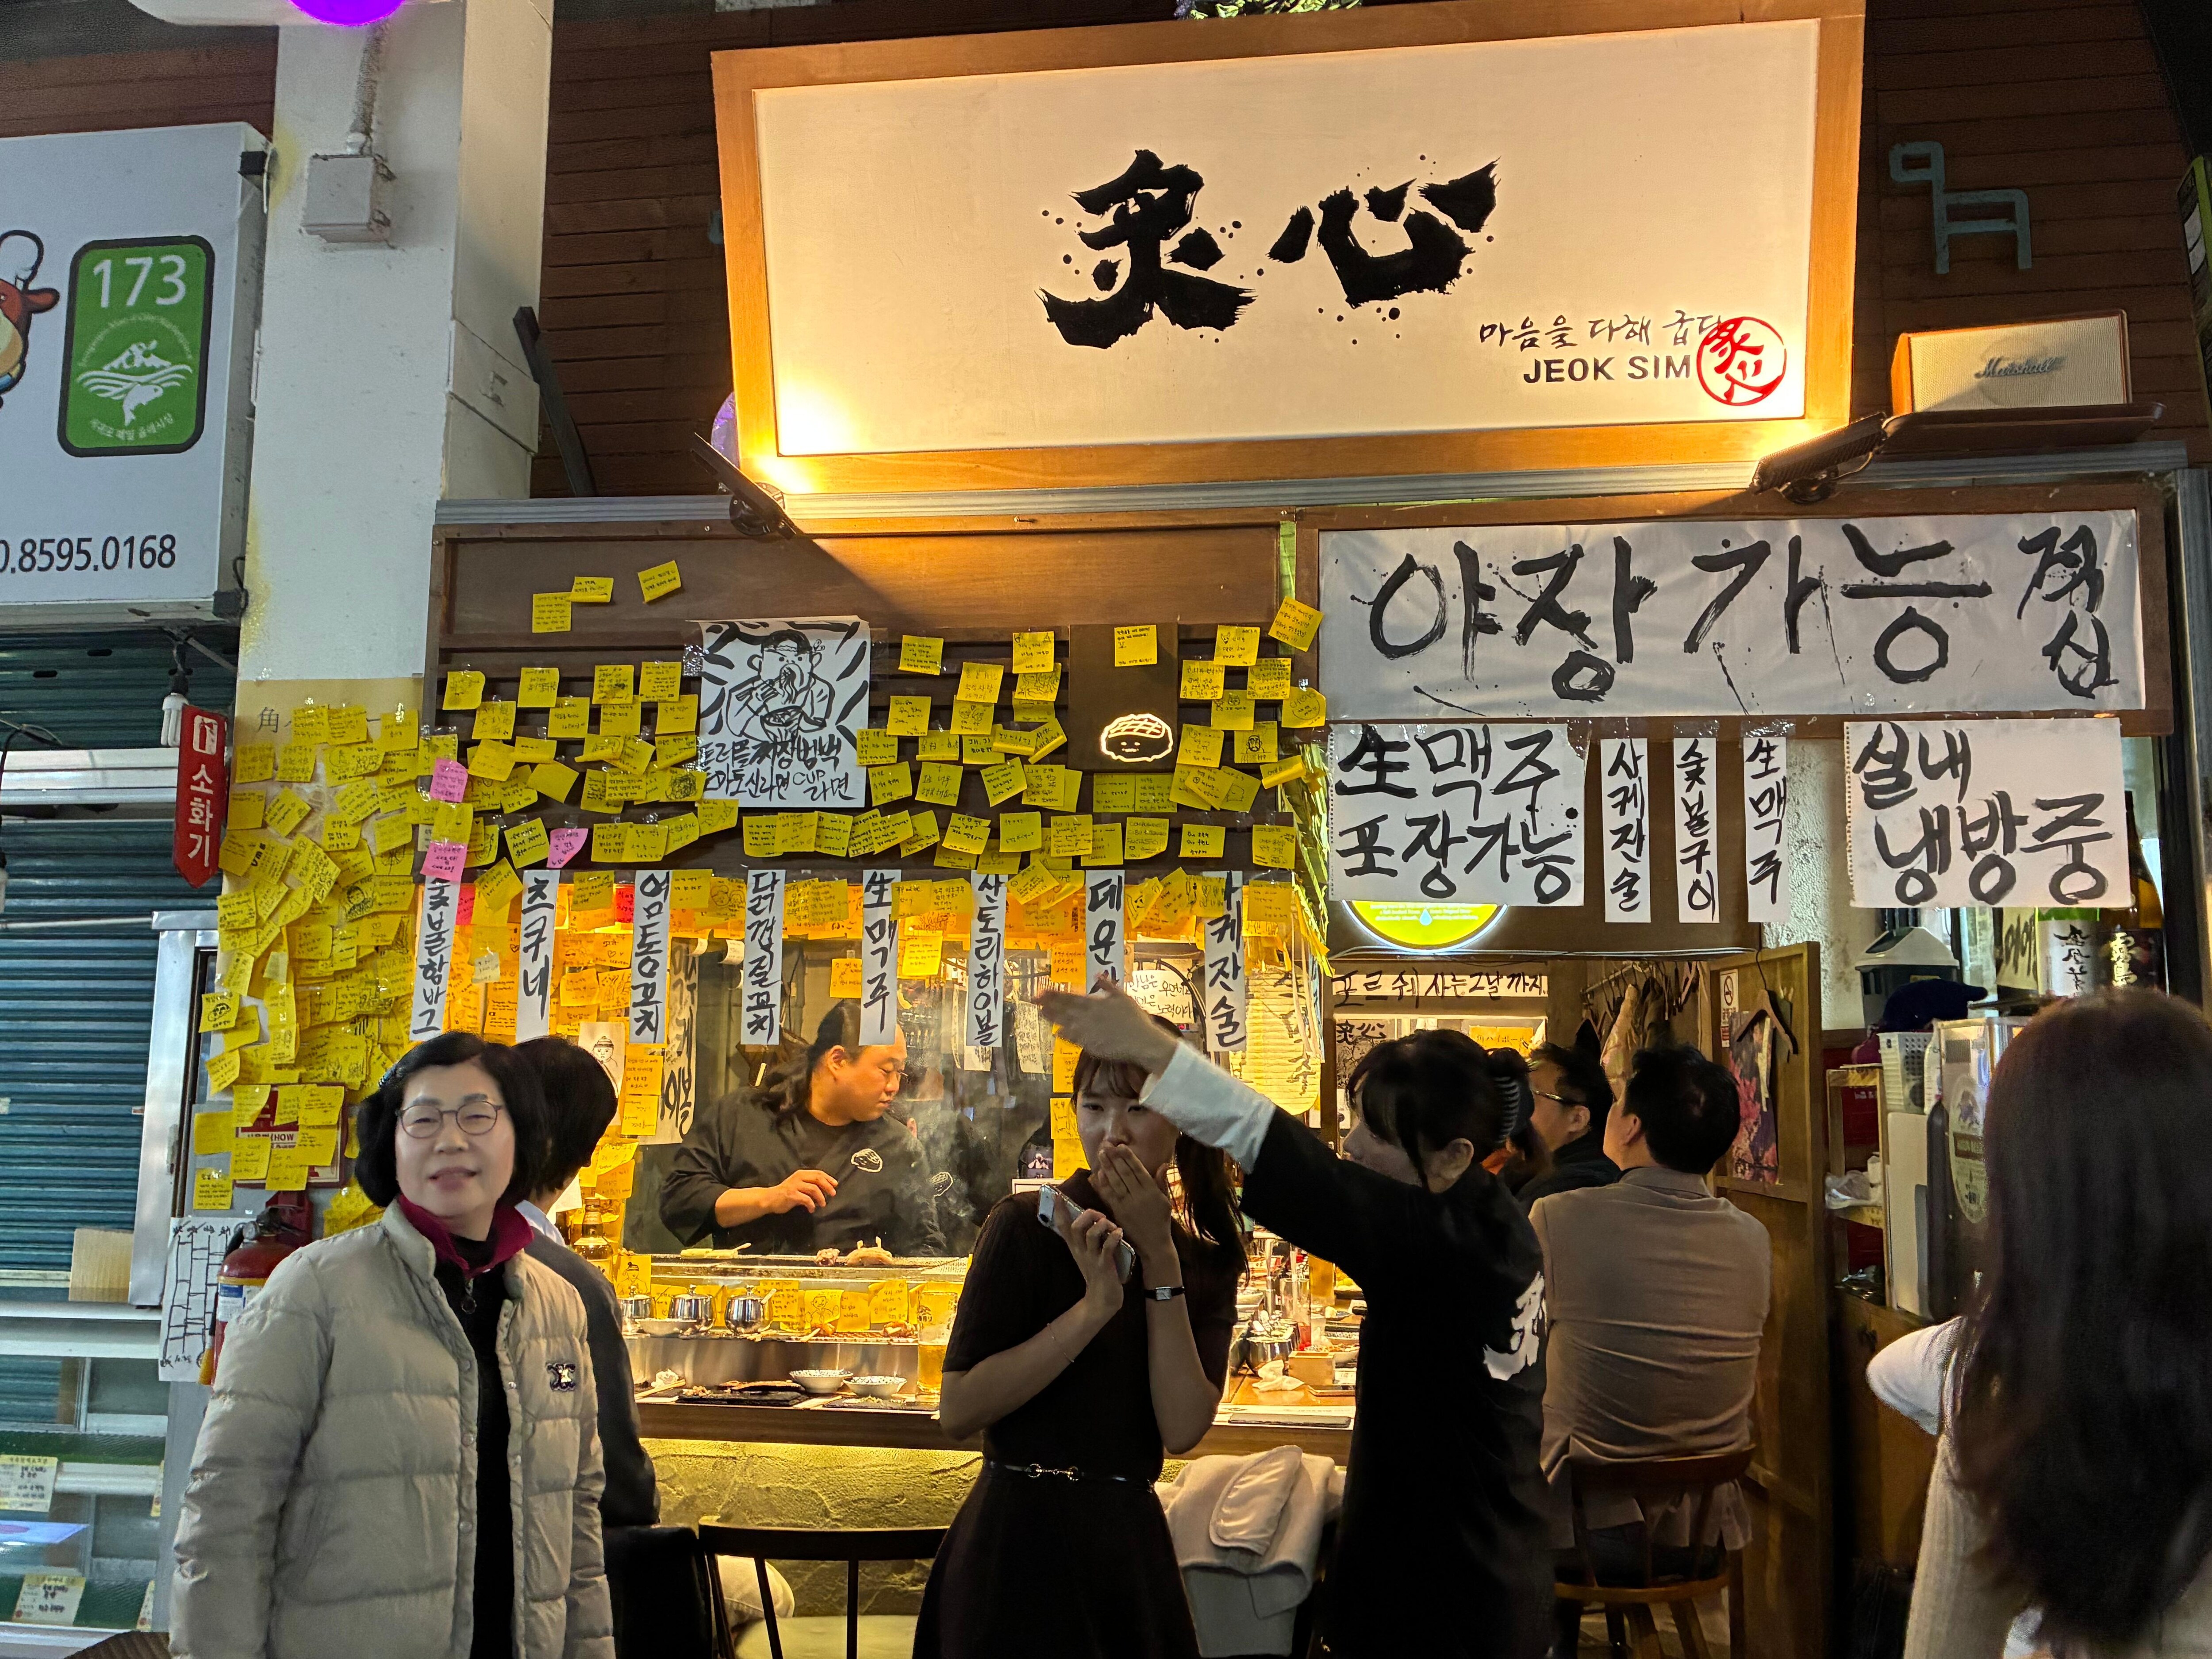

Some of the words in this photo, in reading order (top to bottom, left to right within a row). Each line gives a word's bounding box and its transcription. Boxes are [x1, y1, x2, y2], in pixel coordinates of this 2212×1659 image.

[93, 254, 187, 307] 173
[1479, 315, 1578, 352] 마음을
[1589, 314, 1651, 346] 다해
[1523, 357, 1615, 383] JEOK
[1627, 354, 1690, 379] SIM
[1974, 356, 2057, 379] Marshall
[1369, 523, 1992, 702] 야장가능
[188, 764, 213, 867] 소화기
[793, 769, 826, 786] CUP
[803, 772, 857, 802] 라면
[1335, 724, 1560, 834] 生맥주
[1852, 720, 1972, 810] 실내
[1335, 810, 1573, 904] 포장가능
[1607, 741, 1646, 912] 사케잔술
[1675, 740, 1716, 921] 숯불구이
[1744, 737, 1787, 905] 生맥주
[1875, 790, 2116, 906] 냉방중
[521, 877, 555, 1021] 츠쿠네
[631, 871, 670, 1044] 염통꼬치
[746, 872, 782, 1044] 닭껍질꼬치
[973, 873, 1002, 1046] 산토리하이볼
[1087, 876, 1124, 995] 데운사
[1331, 967, 1419, 1008] 포르쉐
